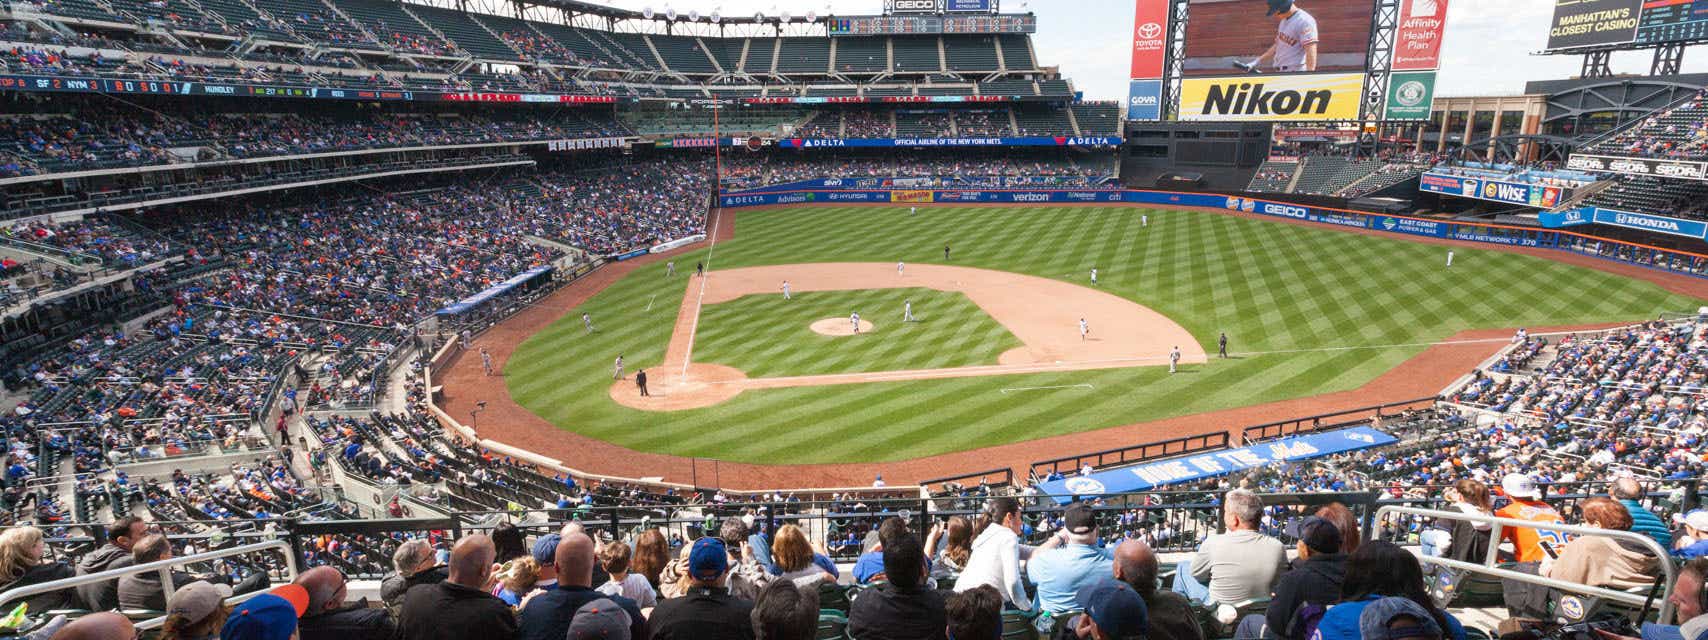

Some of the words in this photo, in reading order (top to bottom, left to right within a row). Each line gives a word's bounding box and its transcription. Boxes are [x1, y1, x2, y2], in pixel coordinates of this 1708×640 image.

[1559, 8, 1630, 26] MANHATTAN'S
[1403, 19, 1441, 29] Affinity
[1551, 24, 1592, 37] CLOSEST
[1595, 18, 1636, 32] CASINO
[1403, 30, 1436, 40] Health
[1408, 41, 1429, 49] Plan
[53, 80, 60, 88] 2
[67, 80, 88, 88] NYM
[90, 81, 97, 89] 3
[1132, 96, 1156, 104] GOYA
[1202, 83, 1332, 114] Nikon
[1013, 192, 1048, 200] verizon
[1498, 184, 1526, 201] WISE
[1264, 204, 1306, 217] GEICO
[1628, 216, 1679, 230] HONDA
